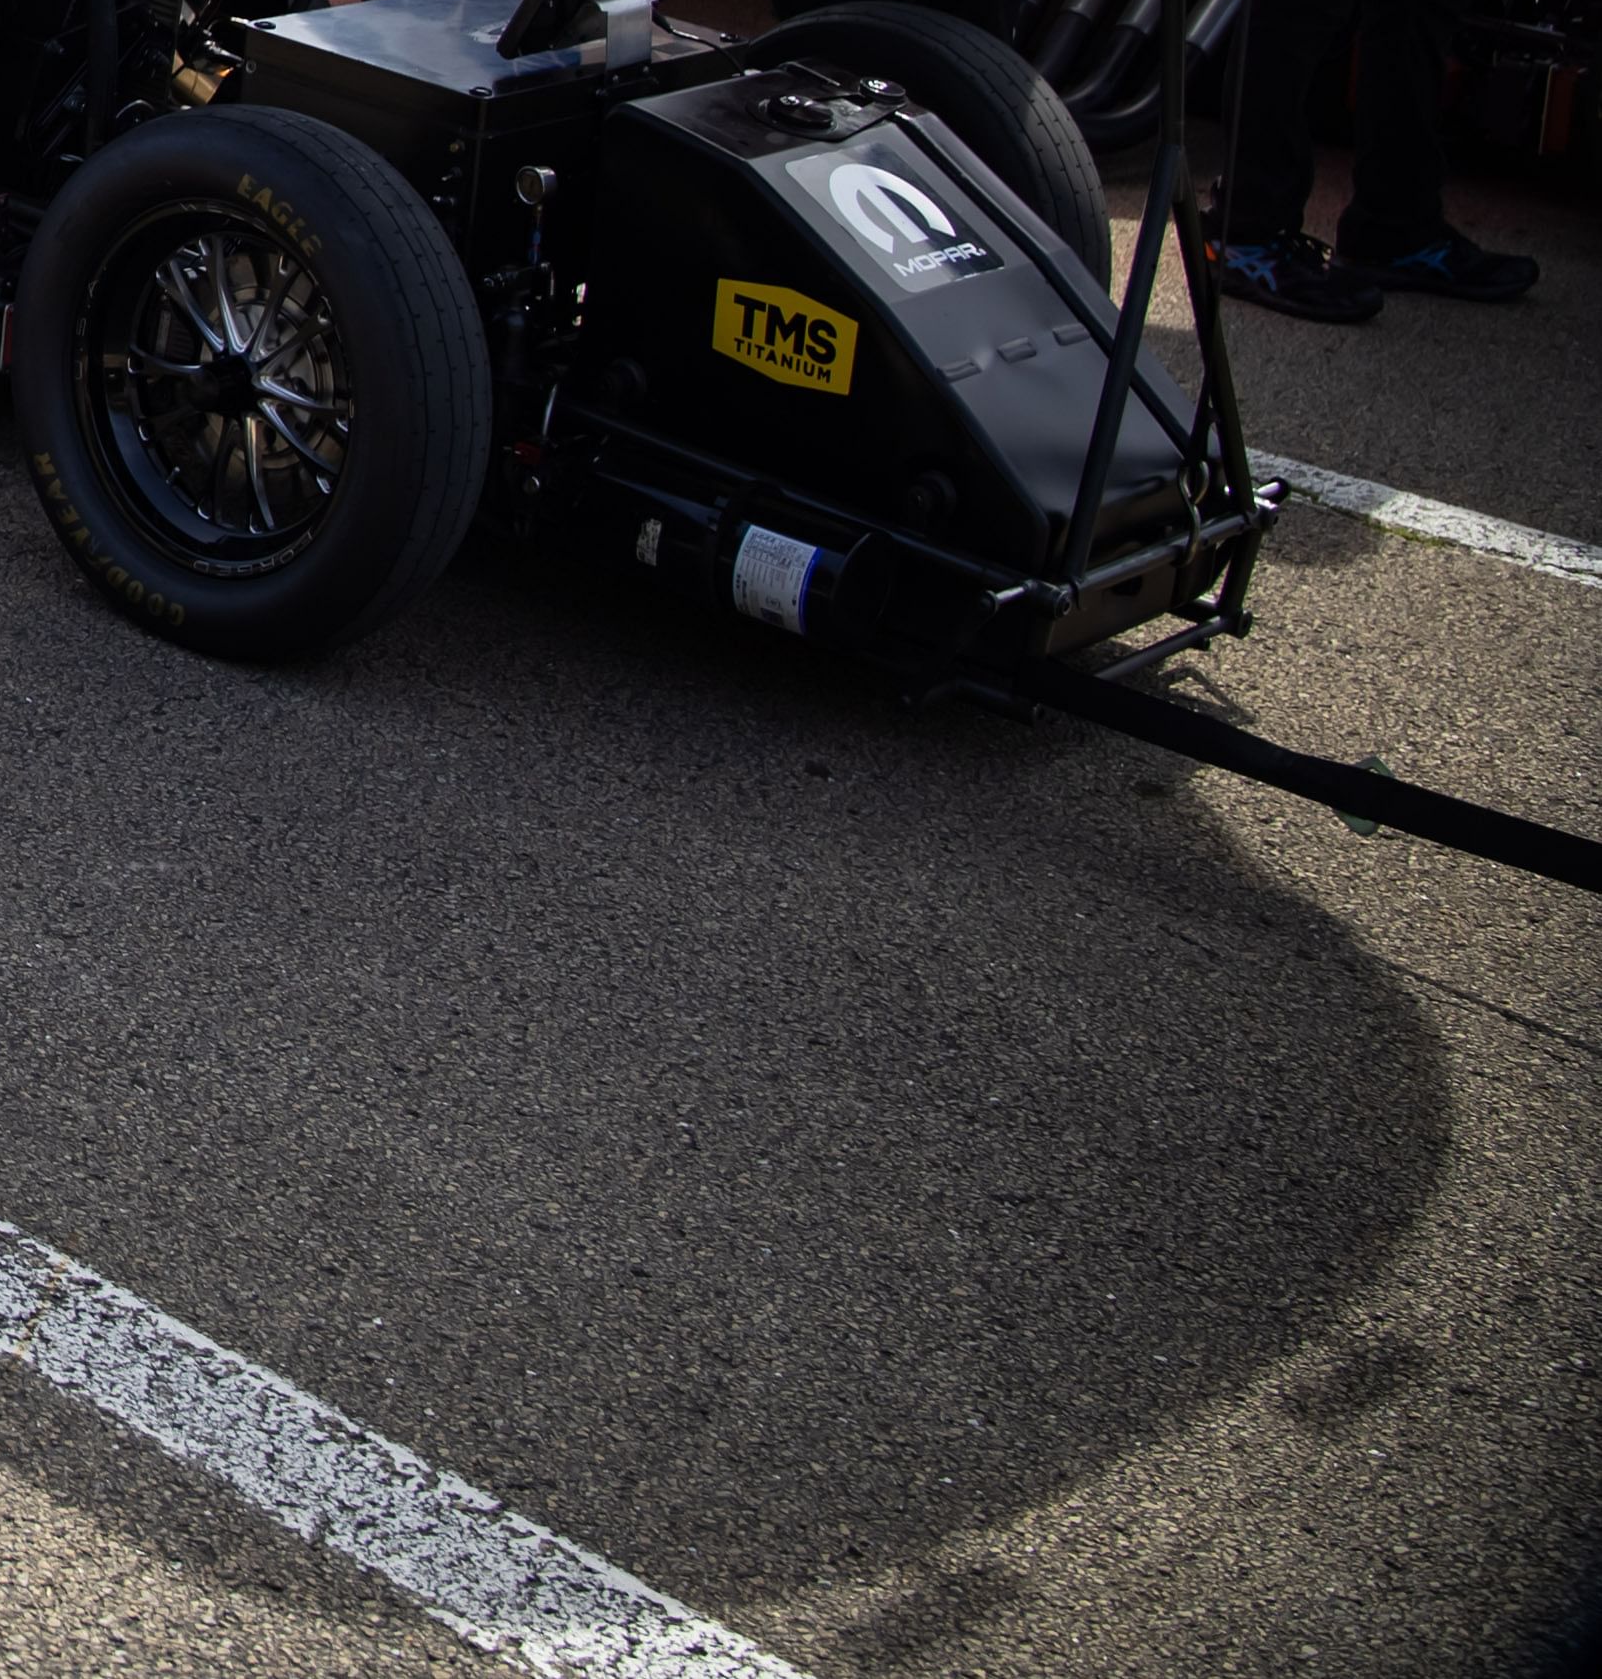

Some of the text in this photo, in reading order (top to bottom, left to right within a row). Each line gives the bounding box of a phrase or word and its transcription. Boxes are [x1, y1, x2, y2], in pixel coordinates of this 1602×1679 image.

[236, 173, 323, 259] EAGLE
[893, 242, 982, 277] MOPAR
[733, 292, 837, 366] TMS
[734, 337, 832, 384] TITANIUM
